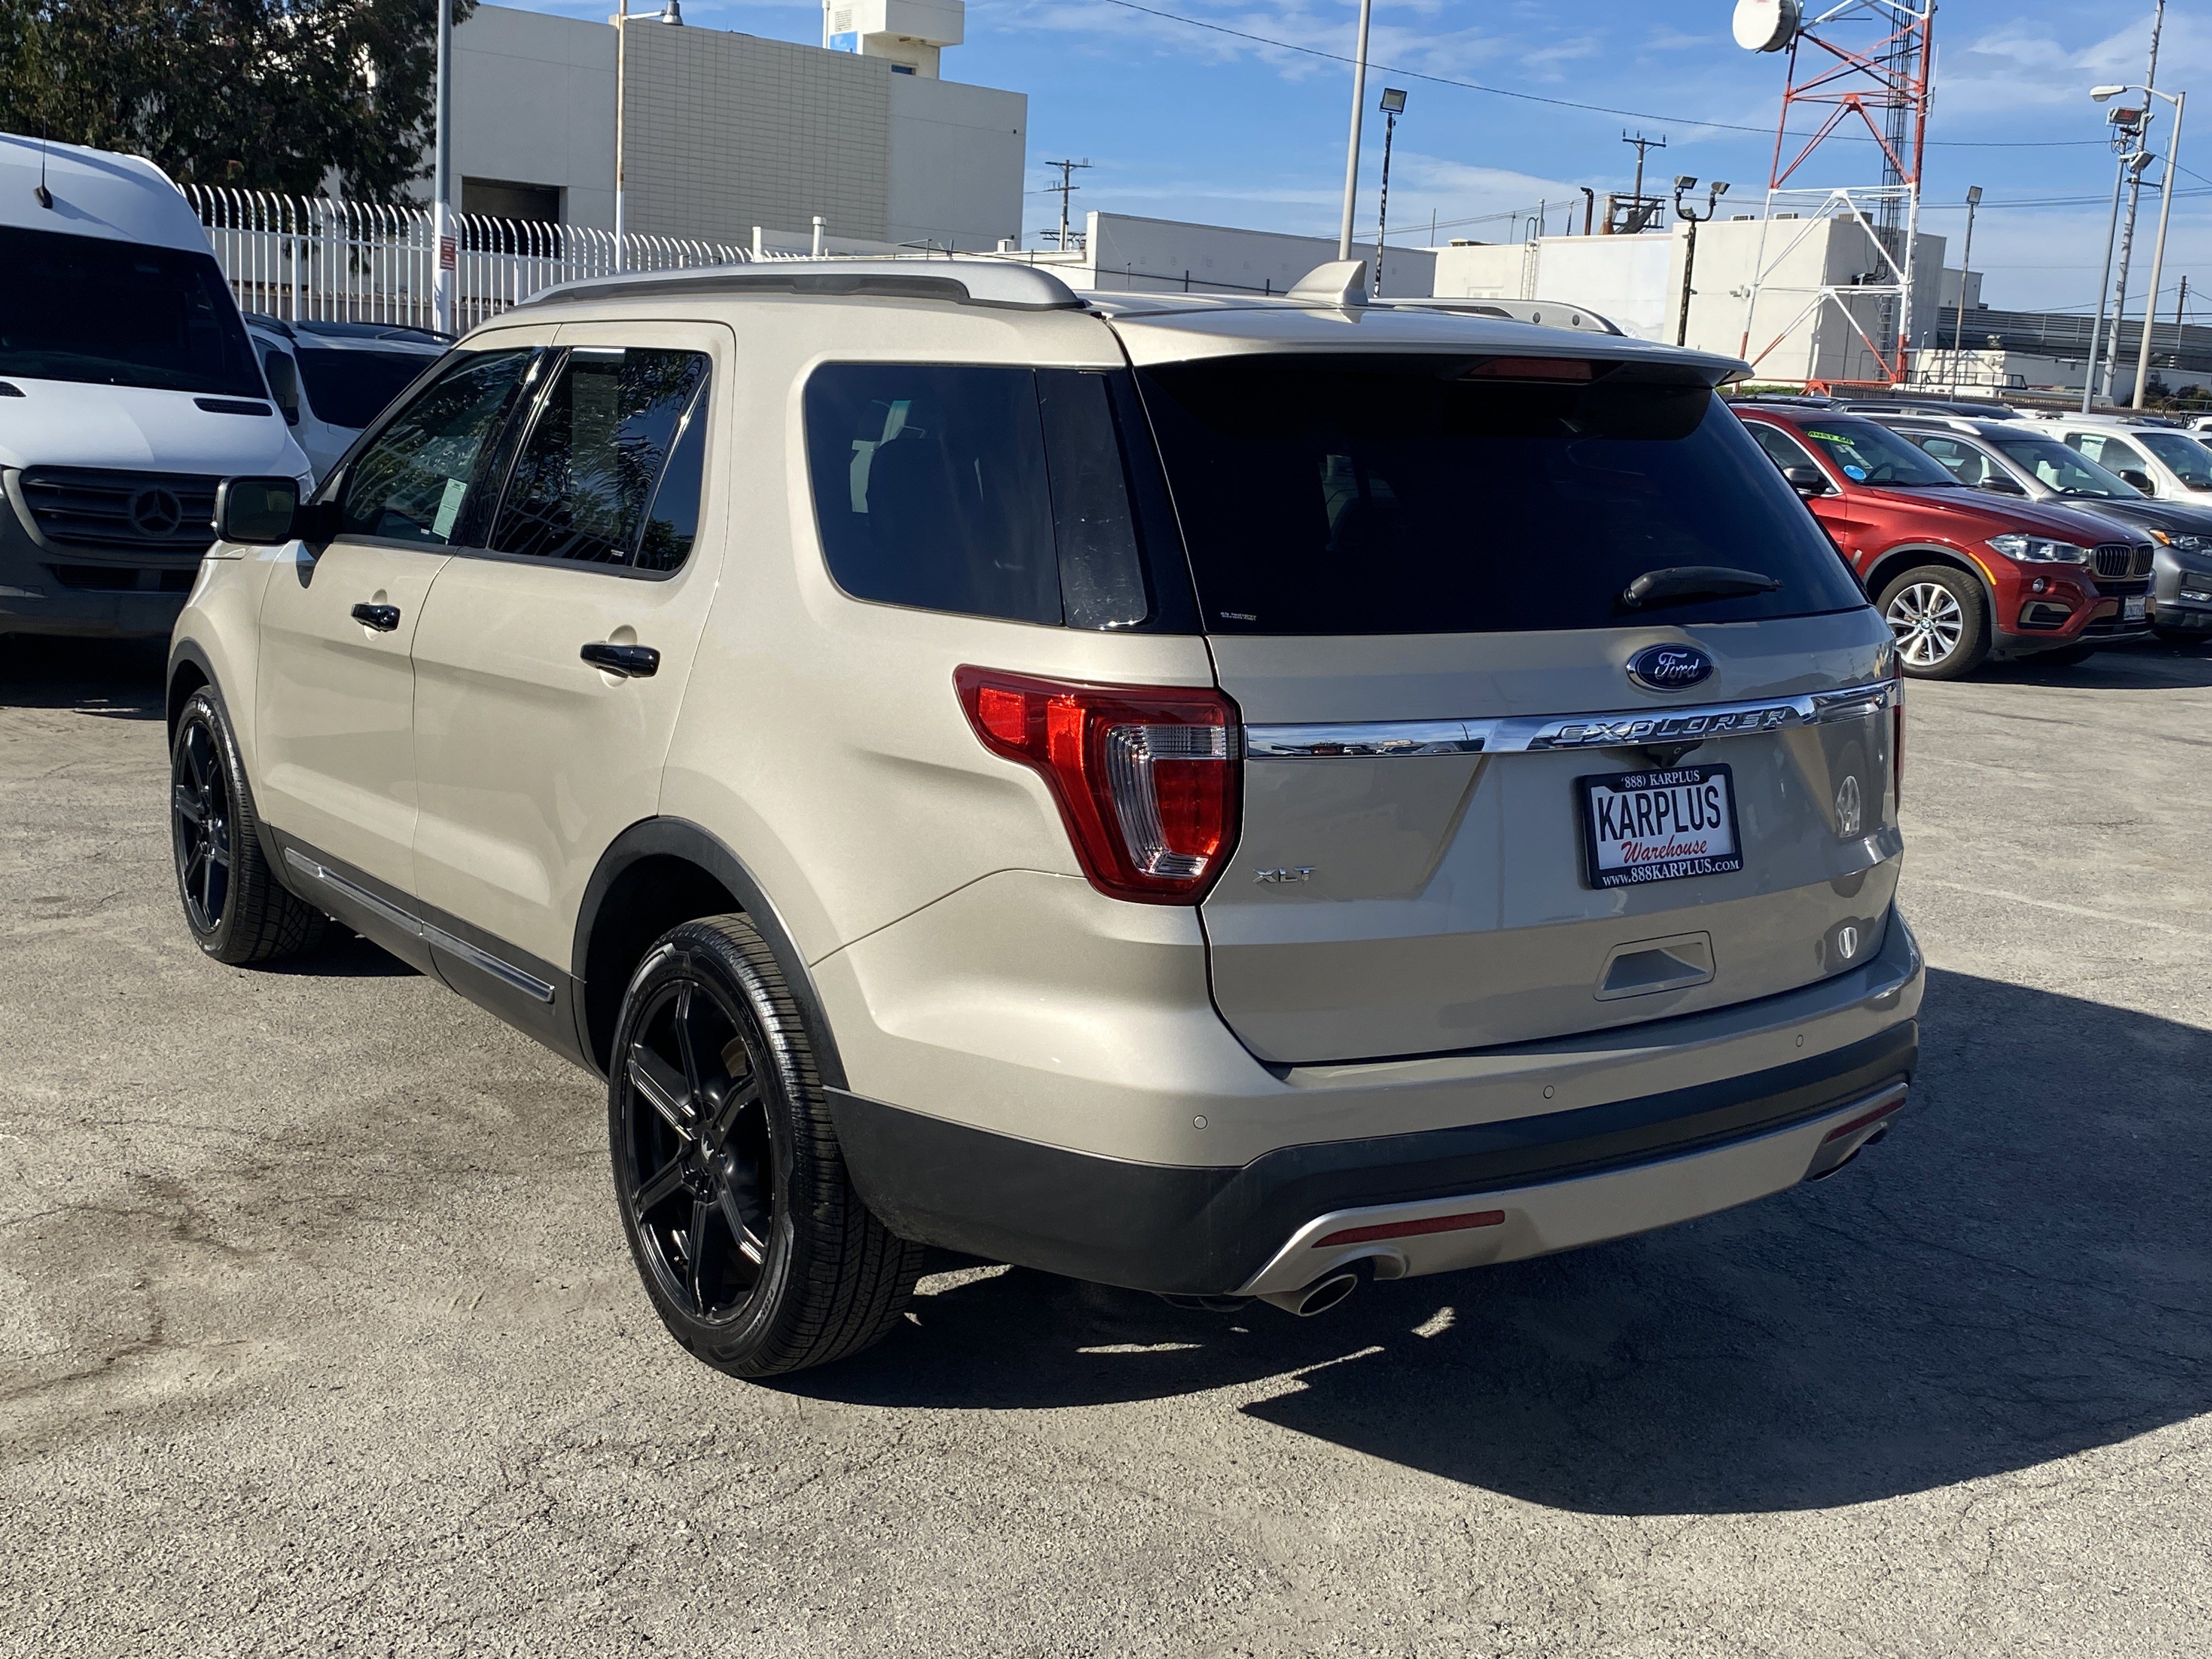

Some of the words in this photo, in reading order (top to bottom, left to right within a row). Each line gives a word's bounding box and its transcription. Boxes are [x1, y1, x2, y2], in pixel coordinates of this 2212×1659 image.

[1655, 652, 1700, 679] Ford
[1554, 710, 1787, 742] EXPLORER
[1649, 770, 1700, 786] KARPLUS
[1598, 785, 1720, 842] KARPLUS
[1621, 834, 1708, 864] Warehouse
[1252, 866, 1317, 883] XLT
